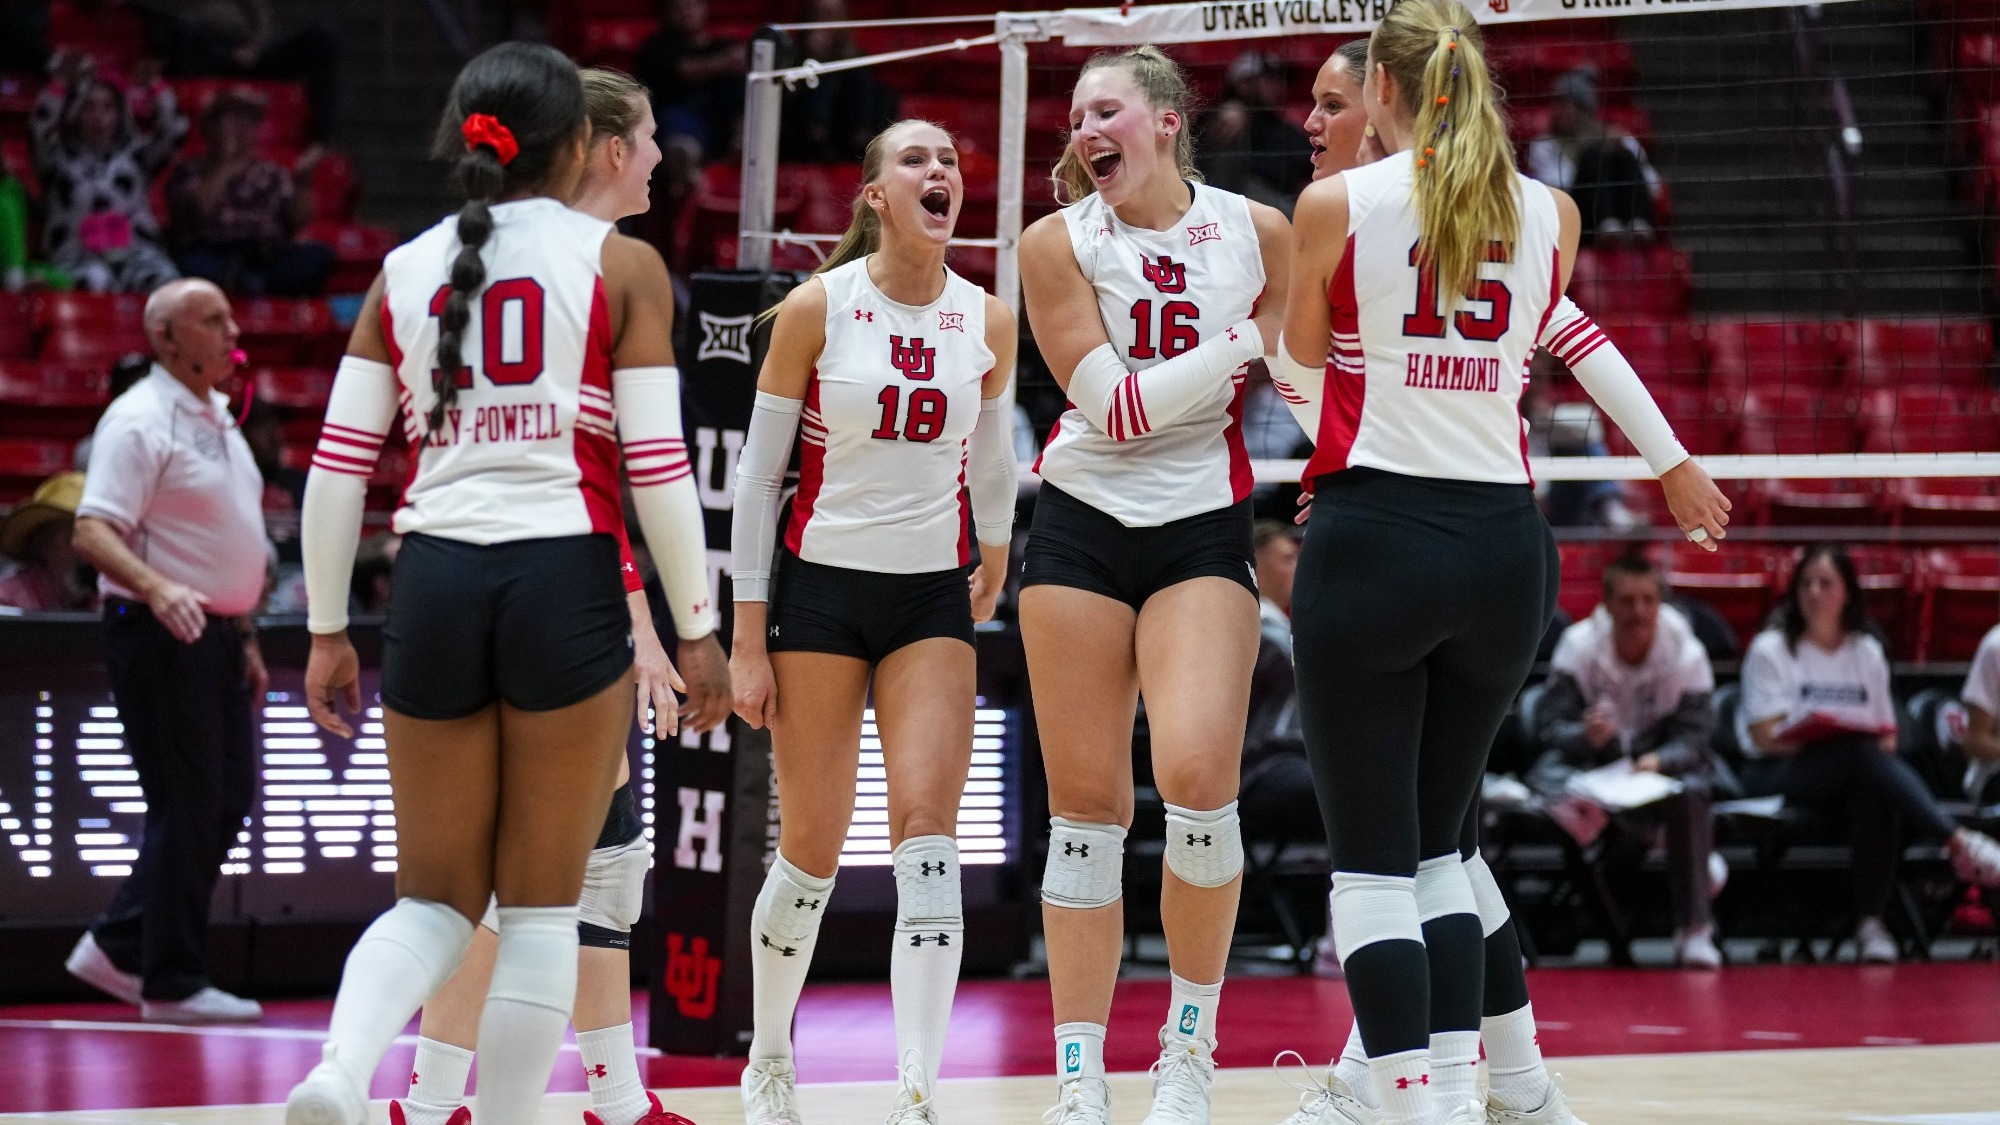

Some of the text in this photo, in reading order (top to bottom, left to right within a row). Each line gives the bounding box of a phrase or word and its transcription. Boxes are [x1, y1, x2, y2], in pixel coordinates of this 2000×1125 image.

[1203, 0, 1394, 31] UTAH VOLLEYB
[1402, 236, 1513, 342] 15
[1129, 299, 1200, 360] 16
[1405, 353, 1500, 392] HAMMOND
[871, 385, 948, 443] 18
